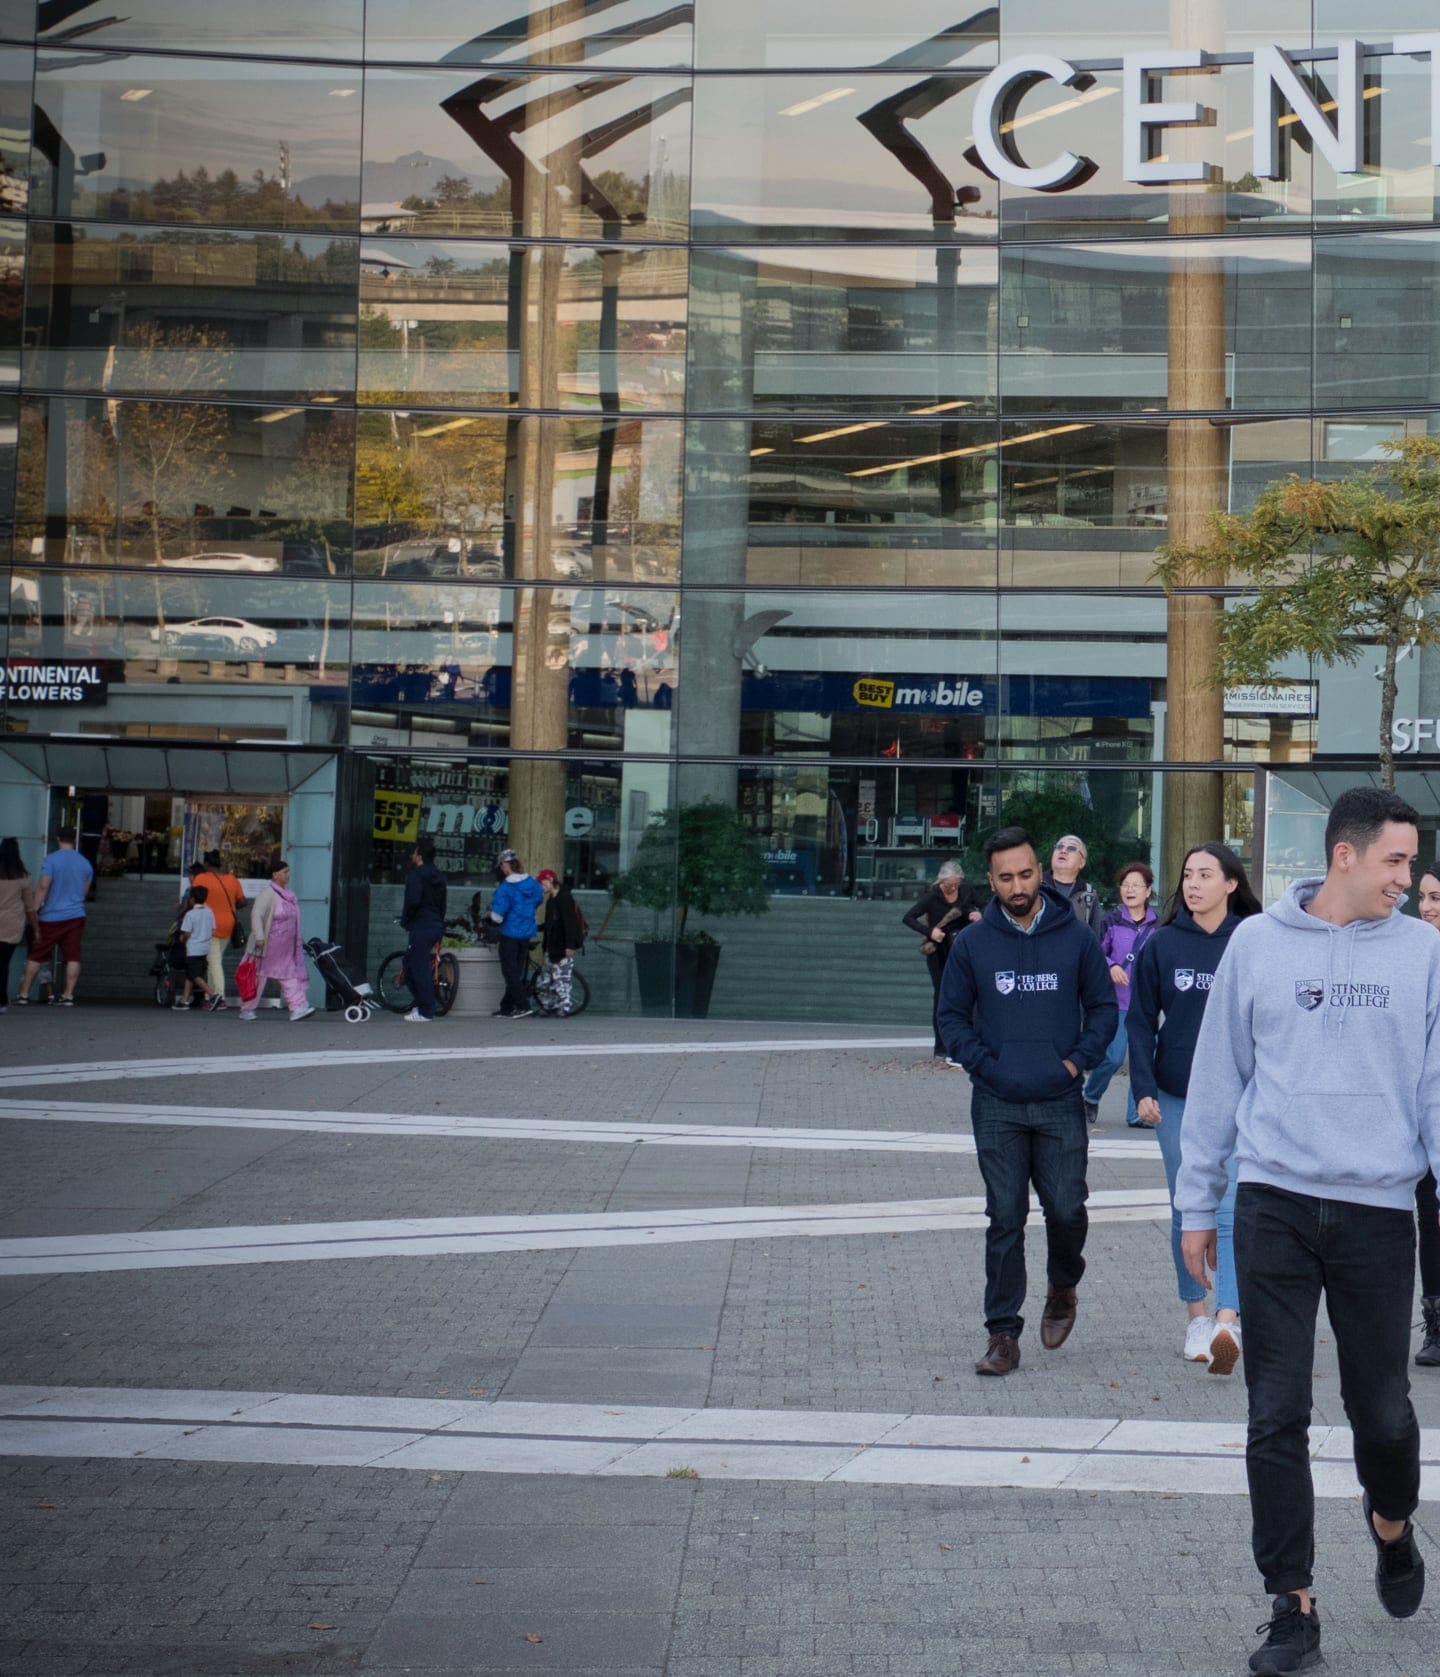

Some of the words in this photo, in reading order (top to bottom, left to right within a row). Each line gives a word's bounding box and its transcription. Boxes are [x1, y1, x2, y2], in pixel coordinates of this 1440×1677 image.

[859, 683, 893, 695] BEST
[895, 681, 983, 706] mobile
[859, 692, 888, 703] BUY
[375, 799, 418, 818] EST
[374, 815, 412, 834] UY
[1331, 984, 1390, 996] STENBERG
[1330, 995, 1390, 1008] COLLEGE
